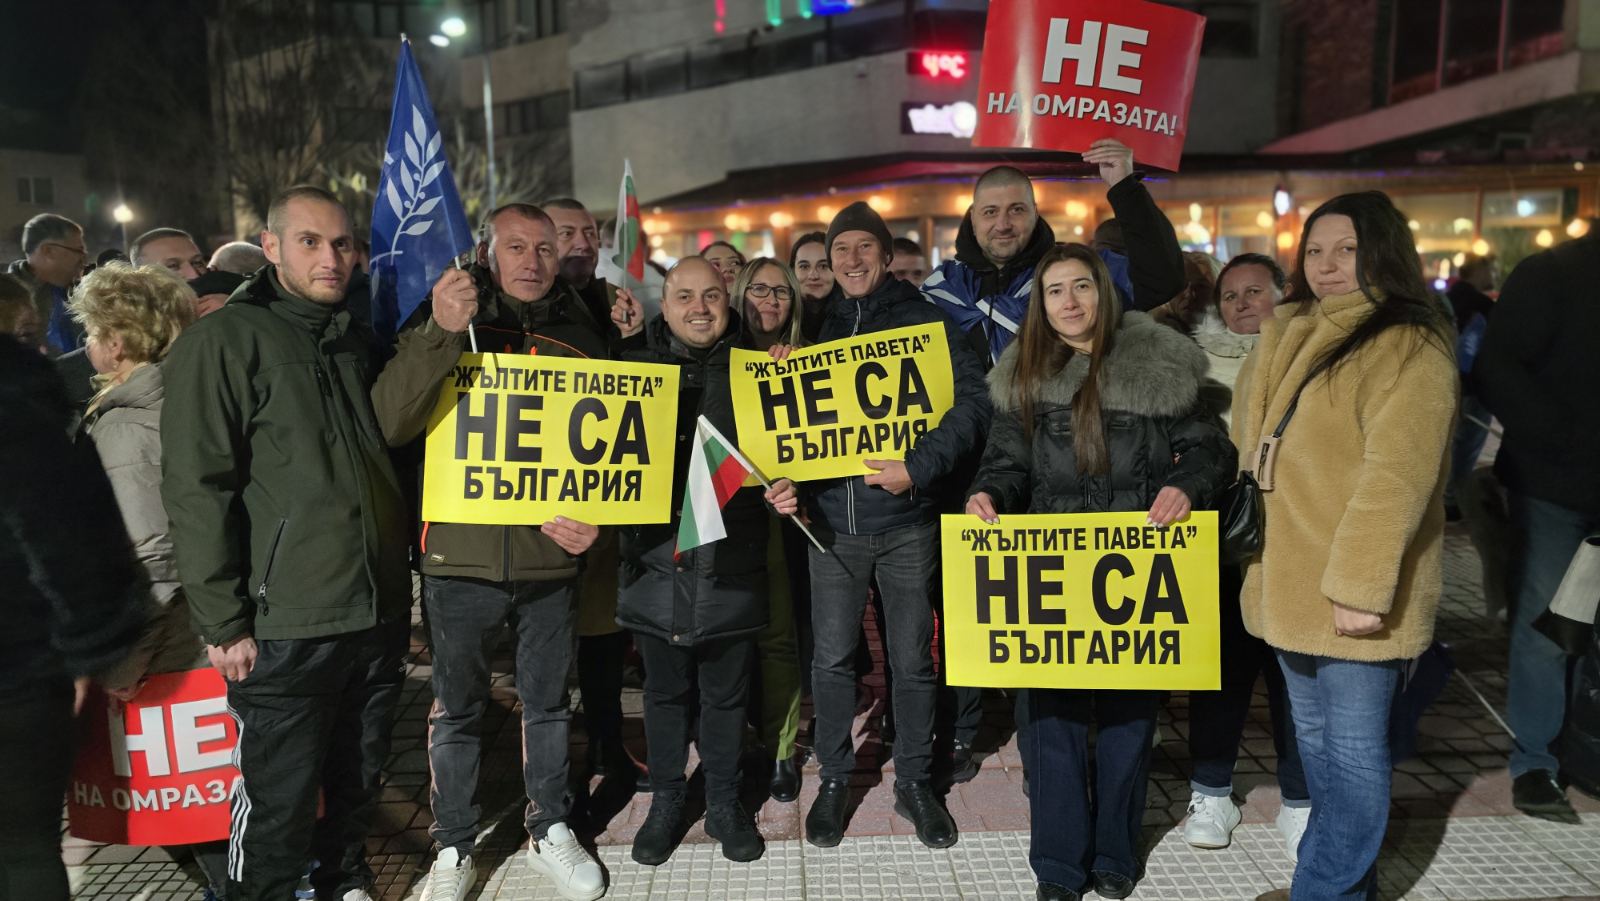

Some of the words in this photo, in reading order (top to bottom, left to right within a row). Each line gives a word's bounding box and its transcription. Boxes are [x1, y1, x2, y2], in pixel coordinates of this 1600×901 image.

[1041, 17, 1149, 95] НЕ
[986, 92, 1023, 114] НА
[1031, 93, 1178, 136] ОМРАЗАТА!
[758, 369, 839, 431] НЕ
[855, 357, 934, 420] СА
[454, 391, 544, 463] НЕ
[568, 397, 650, 465] СА
[776, 418, 928, 464] БЪЛГАРИЯ
[464, 466, 642, 502] БЪЛГАРИЯ
[975, 555, 1067, 624] НЕ
[1092, 553, 1189, 625] СА
[989, 630, 1181, 665] БЪЛГАРИЯ
[106, 696, 235, 777] НЕ
[73, 780, 106, 808] НА
